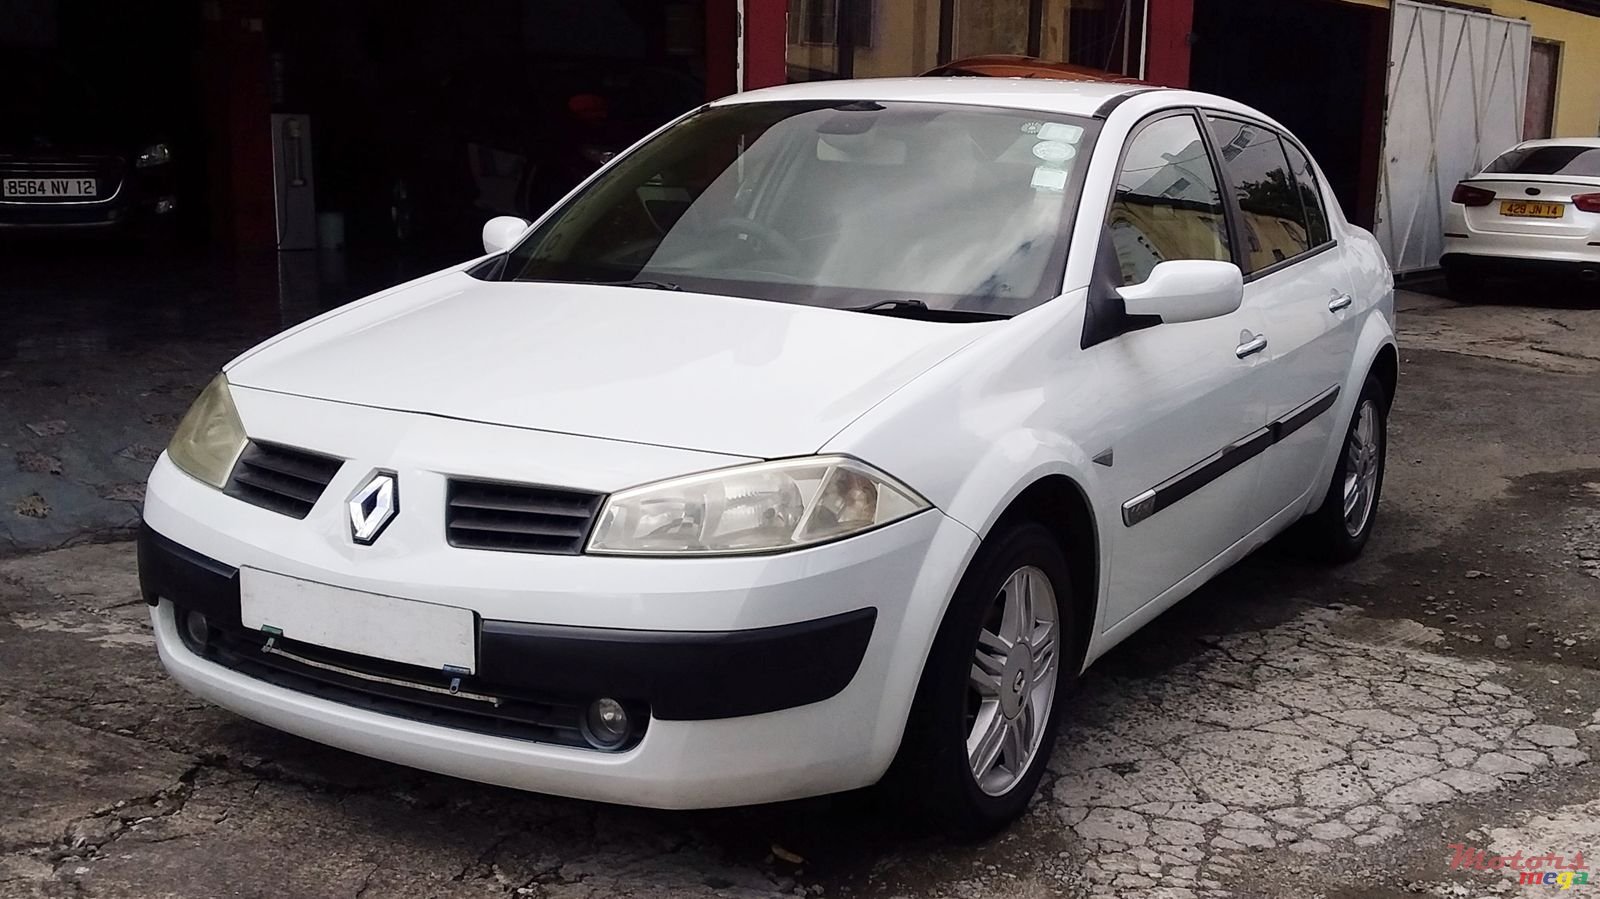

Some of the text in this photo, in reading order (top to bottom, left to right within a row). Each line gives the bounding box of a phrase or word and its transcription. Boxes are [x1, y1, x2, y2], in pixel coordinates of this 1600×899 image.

[8, 180, 93, 195] 8564 NV 12
[1506, 203, 1557, 215] 429 JN 14
